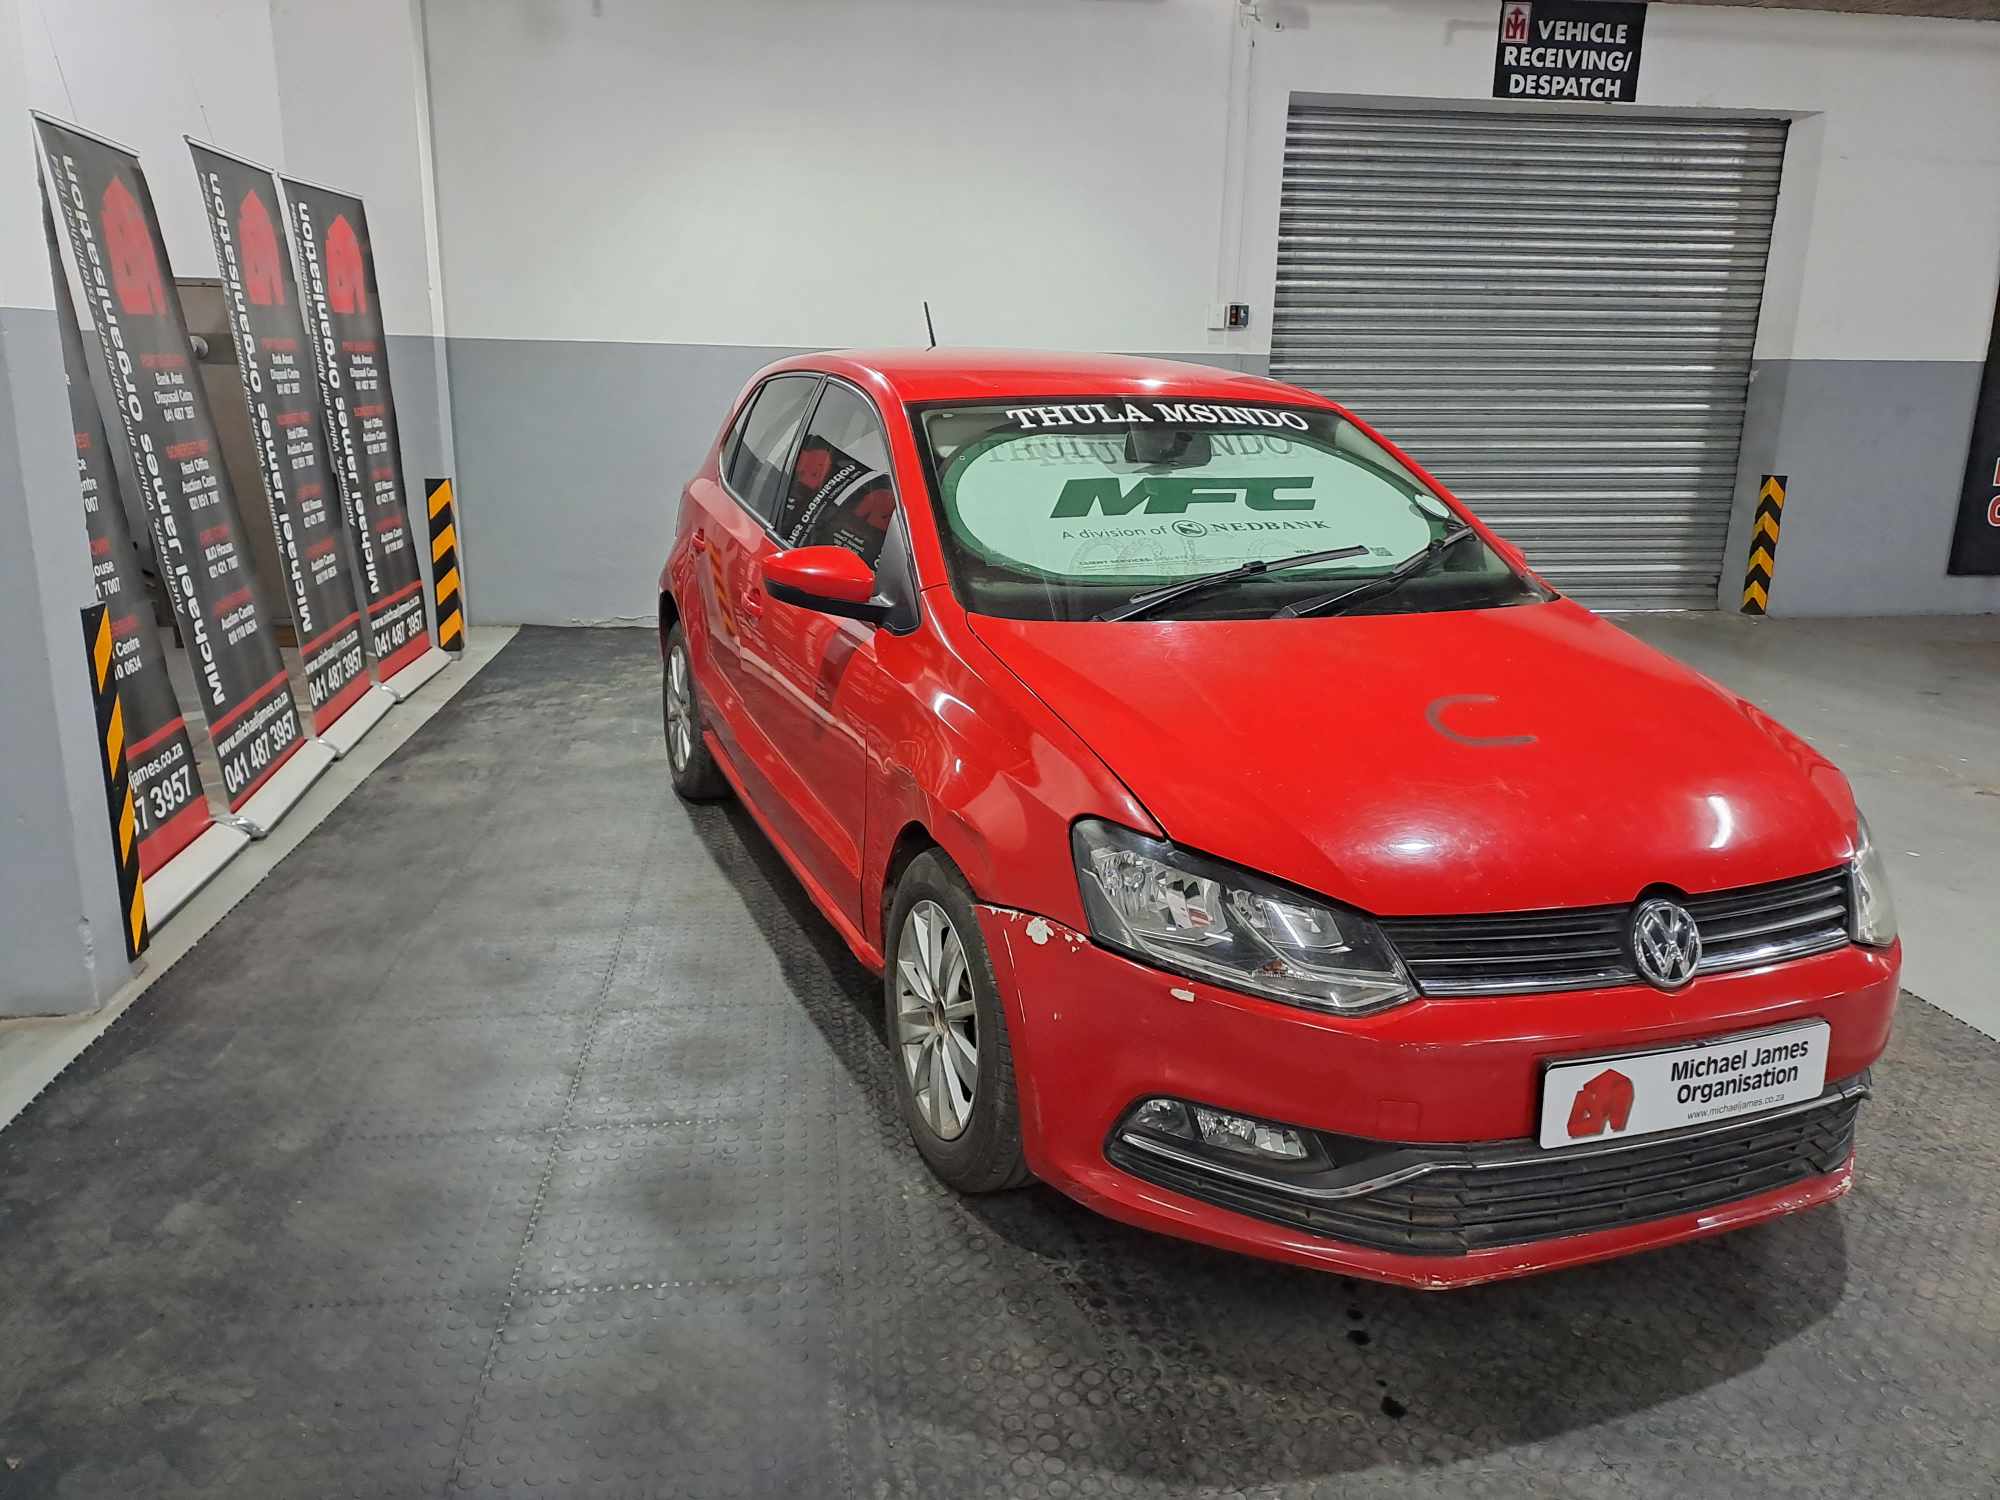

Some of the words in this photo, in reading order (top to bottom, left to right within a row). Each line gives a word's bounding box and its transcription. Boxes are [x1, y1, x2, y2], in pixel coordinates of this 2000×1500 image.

[1538, 20, 1628, 44] VEHICLE
[1504, 46, 1633, 72] RECEIVING/
[1509, 74, 1621, 98] DESPATCH
[63, 156, 142, 420] Organisation
[210, 174, 261, 392] Organisation
[299, 203, 340, 388] Organisation
[97, 321, 127, 410] Appraisers
[121, 414, 137, 447] and
[335, 397, 359, 483] James
[1005, 403, 1154, 429] THULA
[1152, 403, 1310, 431] MSINDO
[258, 403, 286, 503] James
[134, 452, 155, 511] Valuers
[140, 434, 182, 553] James
[1049, 477, 1315, 519] MFC
[352, 492, 379, 593] Michael
[1062, 531, 1074, 540] A
[1079, 526, 1146, 540] division
[1150, 525, 1168, 536] of
[1211, 520, 1331, 532] NEDBANK
[94, 560, 115, 577] ouse
[102, 577, 121, 597] 7007
[279, 514, 312, 632] Michael
[115, 637, 140, 657] Centre
[176, 565, 225, 704] Michael
[374, 630, 393, 657] 041
[391, 620, 406, 644] 487
[406, 609, 423, 637] 3957
[308, 673, 329, 707] 041
[327, 660, 344, 691] 487
[342, 645, 363, 680] 3957
[224, 751, 251, 793] 041
[249, 731, 271, 770] 487
[269, 709, 296, 751] 3957
[149, 764, 192, 818] 3957
[1670, 1055, 1748, 1083] Michael
[1751, 1039, 1809, 1063] James
[1676, 1064, 1799, 1105] Organisation
[1687, 1093, 1785, 1120] www.michaeljames.co.za
